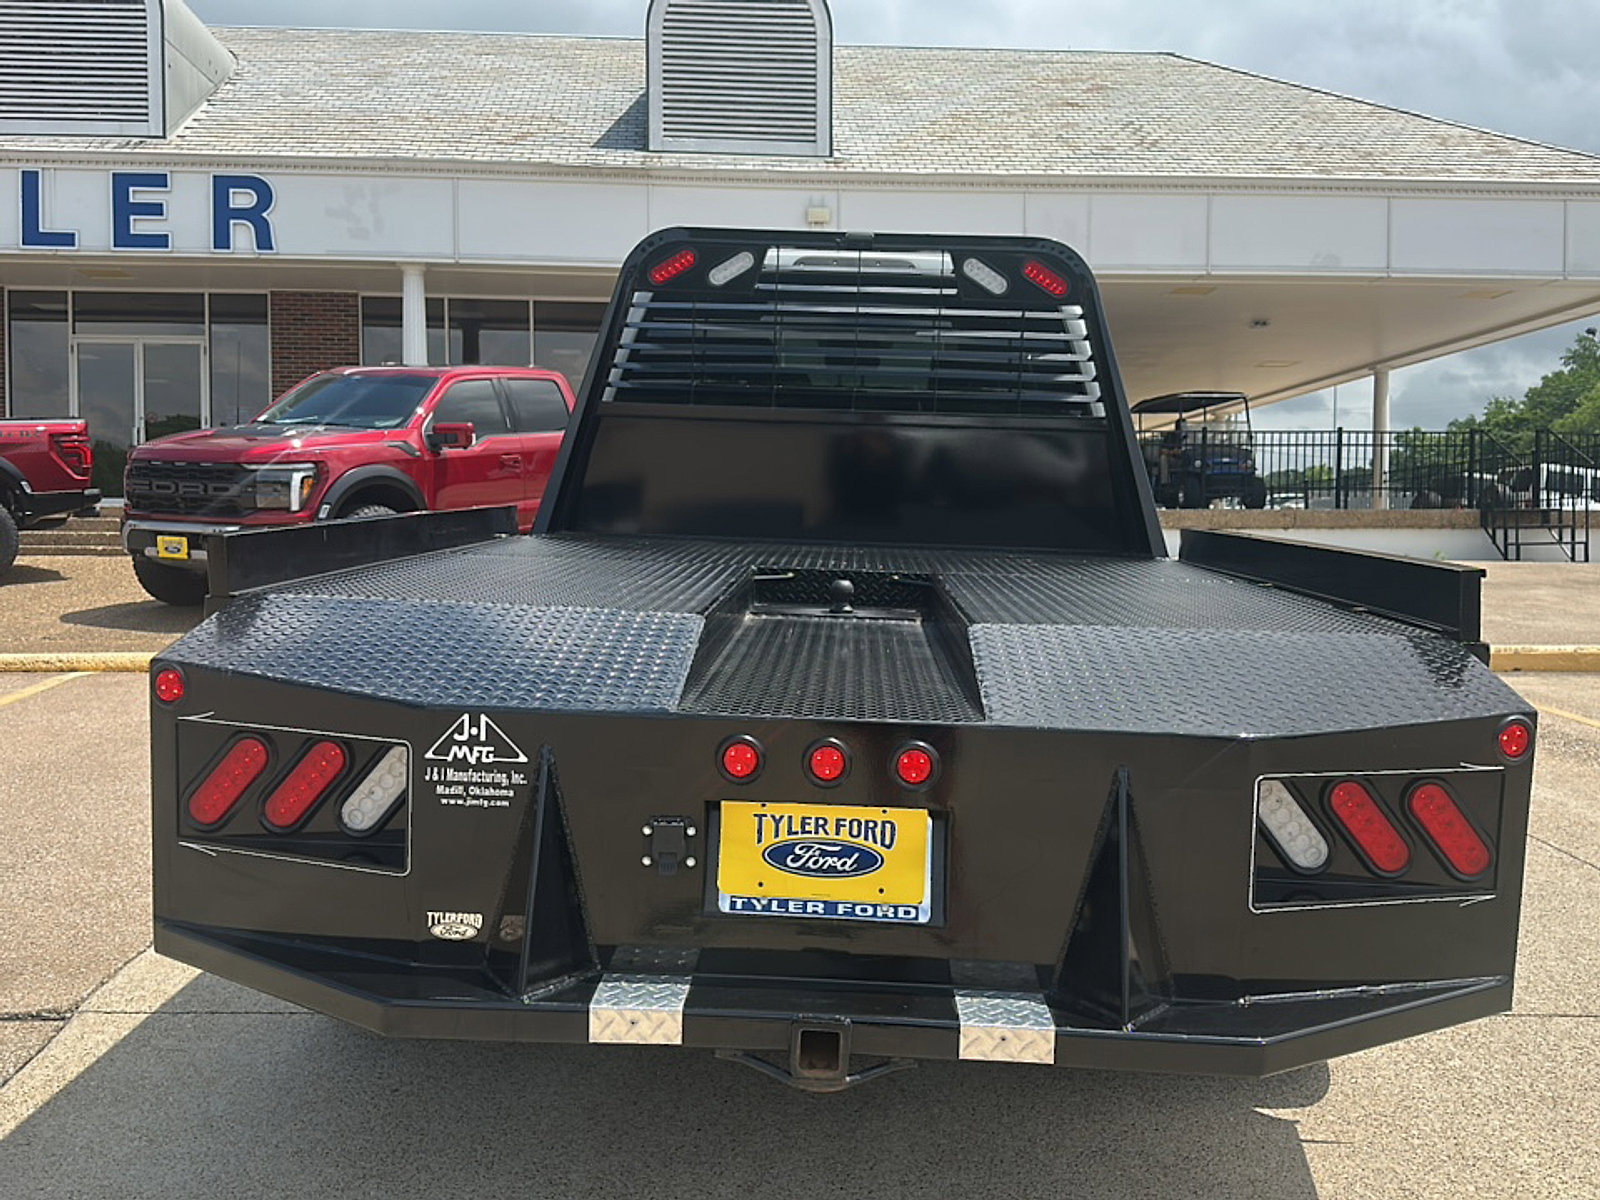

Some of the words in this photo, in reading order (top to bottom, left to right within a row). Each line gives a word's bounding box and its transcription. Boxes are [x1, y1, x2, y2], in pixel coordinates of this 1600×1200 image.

[753, 813, 829, 845] TYLER
[834, 817, 897, 850] FORD
[786, 842, 859, 872] Ford
[731, 898, 825, 914] TYLER
[837, 903, 918, 920] FORD
